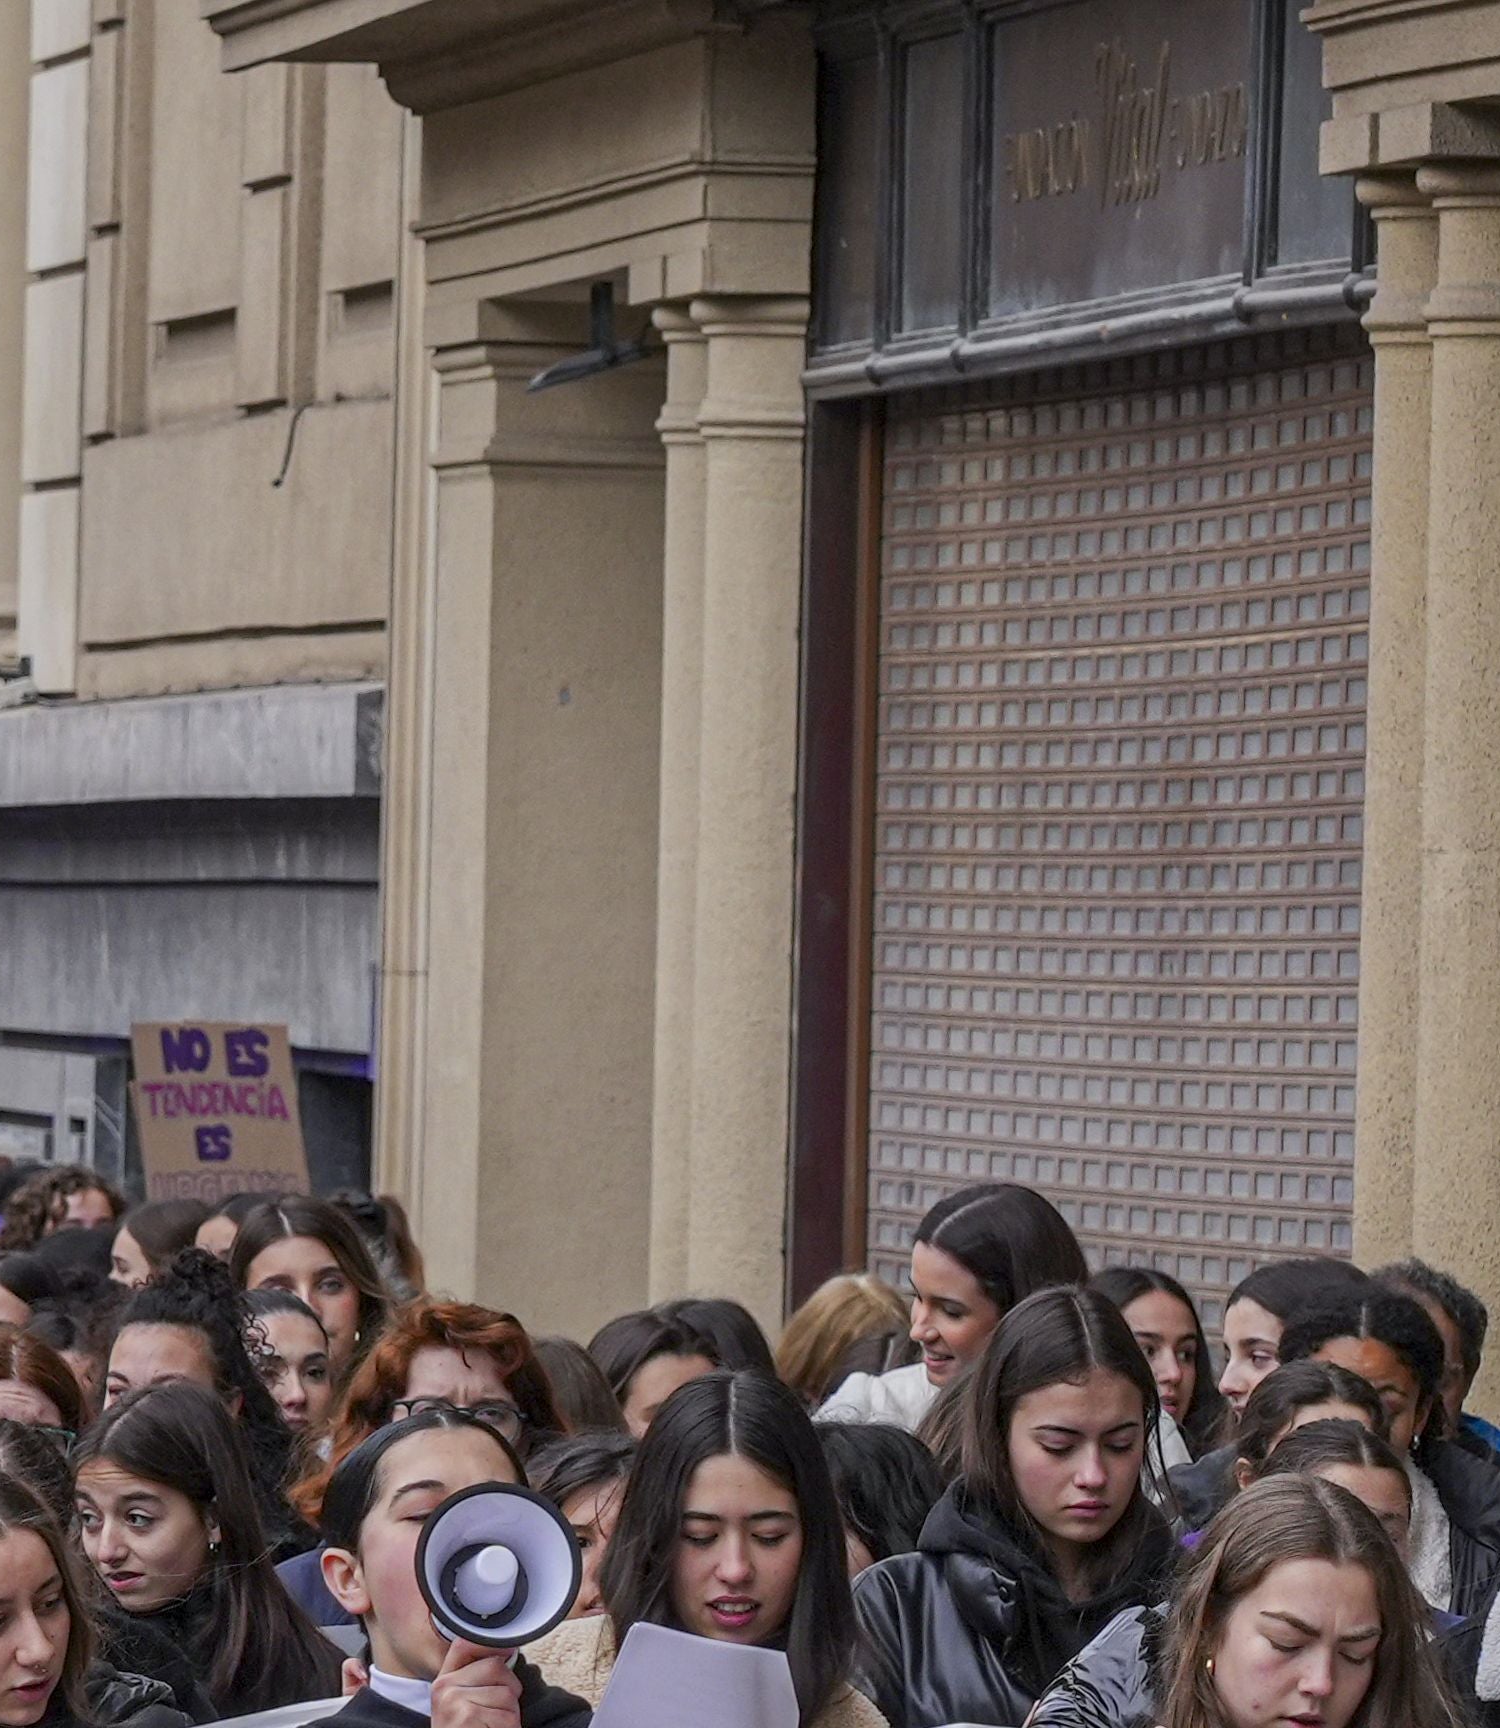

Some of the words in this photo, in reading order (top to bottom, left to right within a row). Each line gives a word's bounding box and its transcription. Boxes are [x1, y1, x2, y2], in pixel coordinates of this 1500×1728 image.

[160, 1027, 211, 1075] NO
[224, 1027, 270, 1078] ES
[194, 1123, 232, 1162] ES
